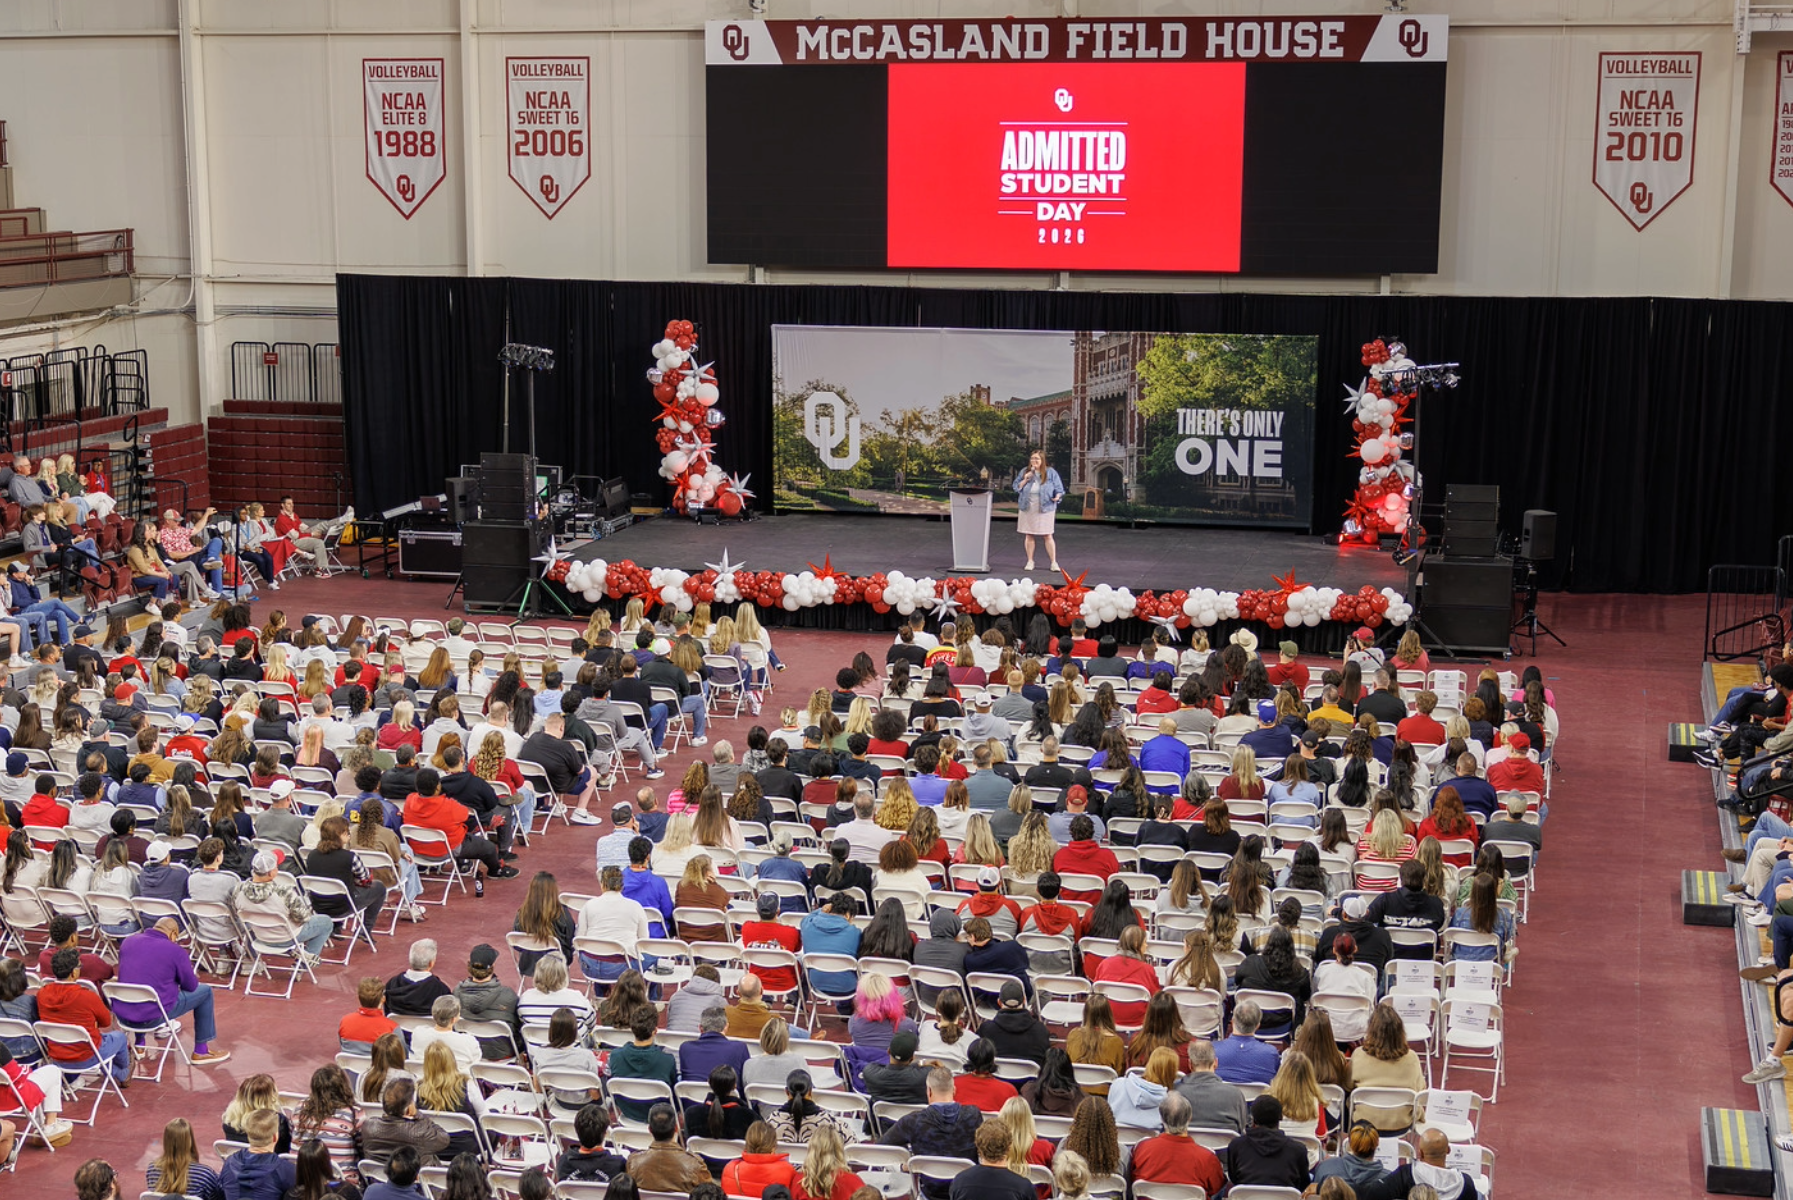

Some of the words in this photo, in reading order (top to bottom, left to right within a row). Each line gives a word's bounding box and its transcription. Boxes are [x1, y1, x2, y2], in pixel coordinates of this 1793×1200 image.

[723, 25, 749, 61] OU
[1067, 23, 1186, 58] FIELD
[1206, 22, 1344, 58] HOUSE
[1399, 19, 1428, 58] OU
[368, 65, 437, 79] VOLLEYBALL
[512, 64, 583, 76] VOLLEYBALL
[1607, 60, 1692, 74] VOLLEYBALL
[382, 93, 426, 110] NCAA
[526, 91, 571, 109] NCAA
[1620, 91, 1674, 110] NCAA
[383, 111, 414, 125] ELITE
[418, 112, 427, 125] 8
[518, 111, 561, 125] SWEET
[565, 111, 579, 125] 16
[1609, 111, 1661, 127] SWEET
[1667, 112, 1683, 127] 16
[375, 131, 435, 157] 1988
[516, 130, 583, 156] 2006
[1001, 131, 1125, 170] ADMITTED
[1606, 132, 1683, 161] 2010
[1001, 173, 1124, 193] STUDENT
[1038, 203, 1086, 220] DAY
[1039, 229, 1084, 243] 2026
[804, 391, 860, 470] OU
[1243, 410, 1284, 437] ONLY
[1175, 438, 1282, 477] ONE
